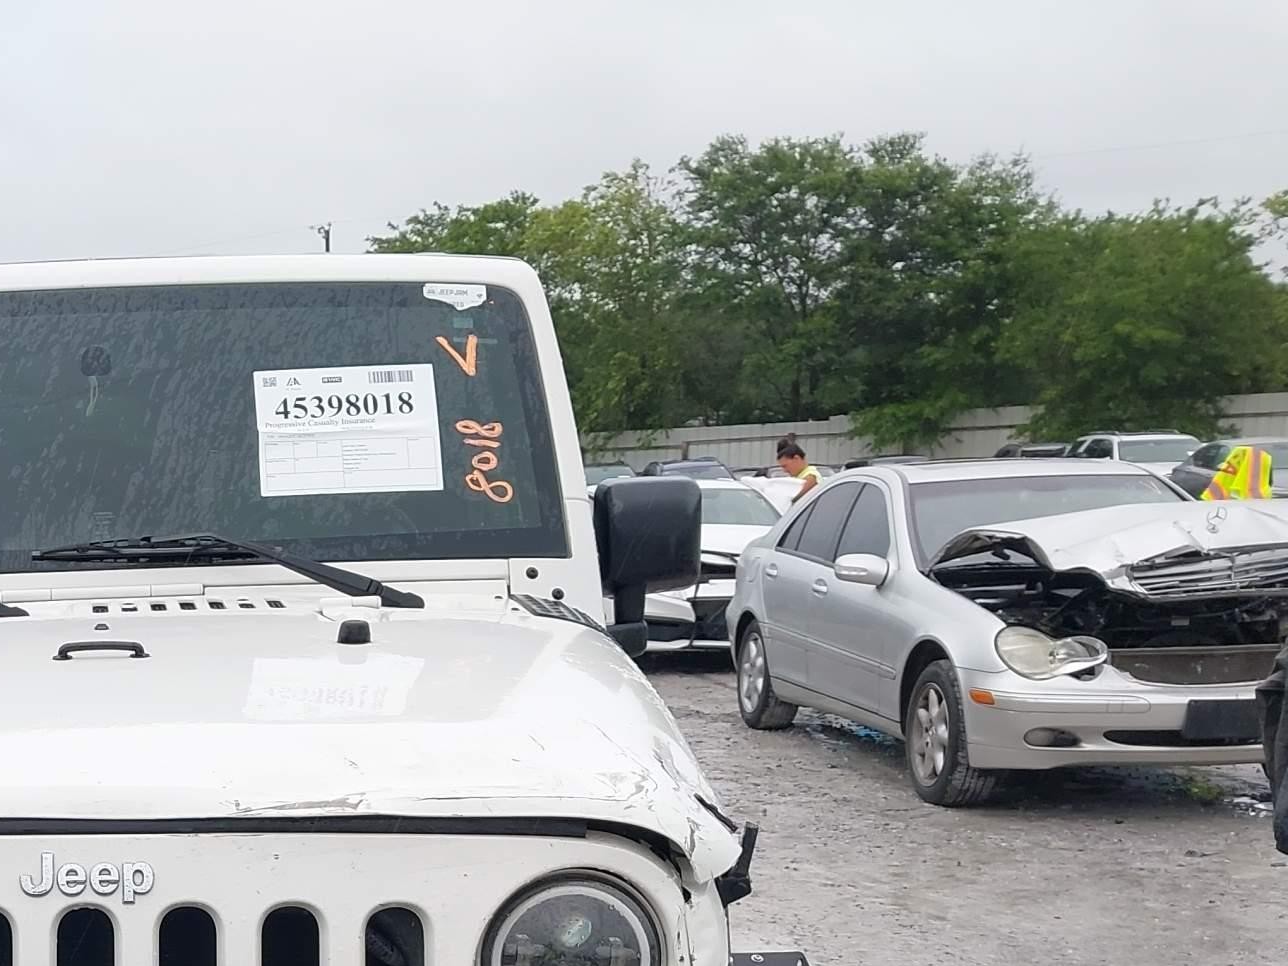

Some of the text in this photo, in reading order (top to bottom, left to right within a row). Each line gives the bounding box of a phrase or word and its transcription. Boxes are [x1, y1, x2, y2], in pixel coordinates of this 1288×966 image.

[275, 391, 414, 419] 45398018
[265, 417, 376, 429] Progressive Casualty Insurance
[19, 852, 155, 904] Jeep
